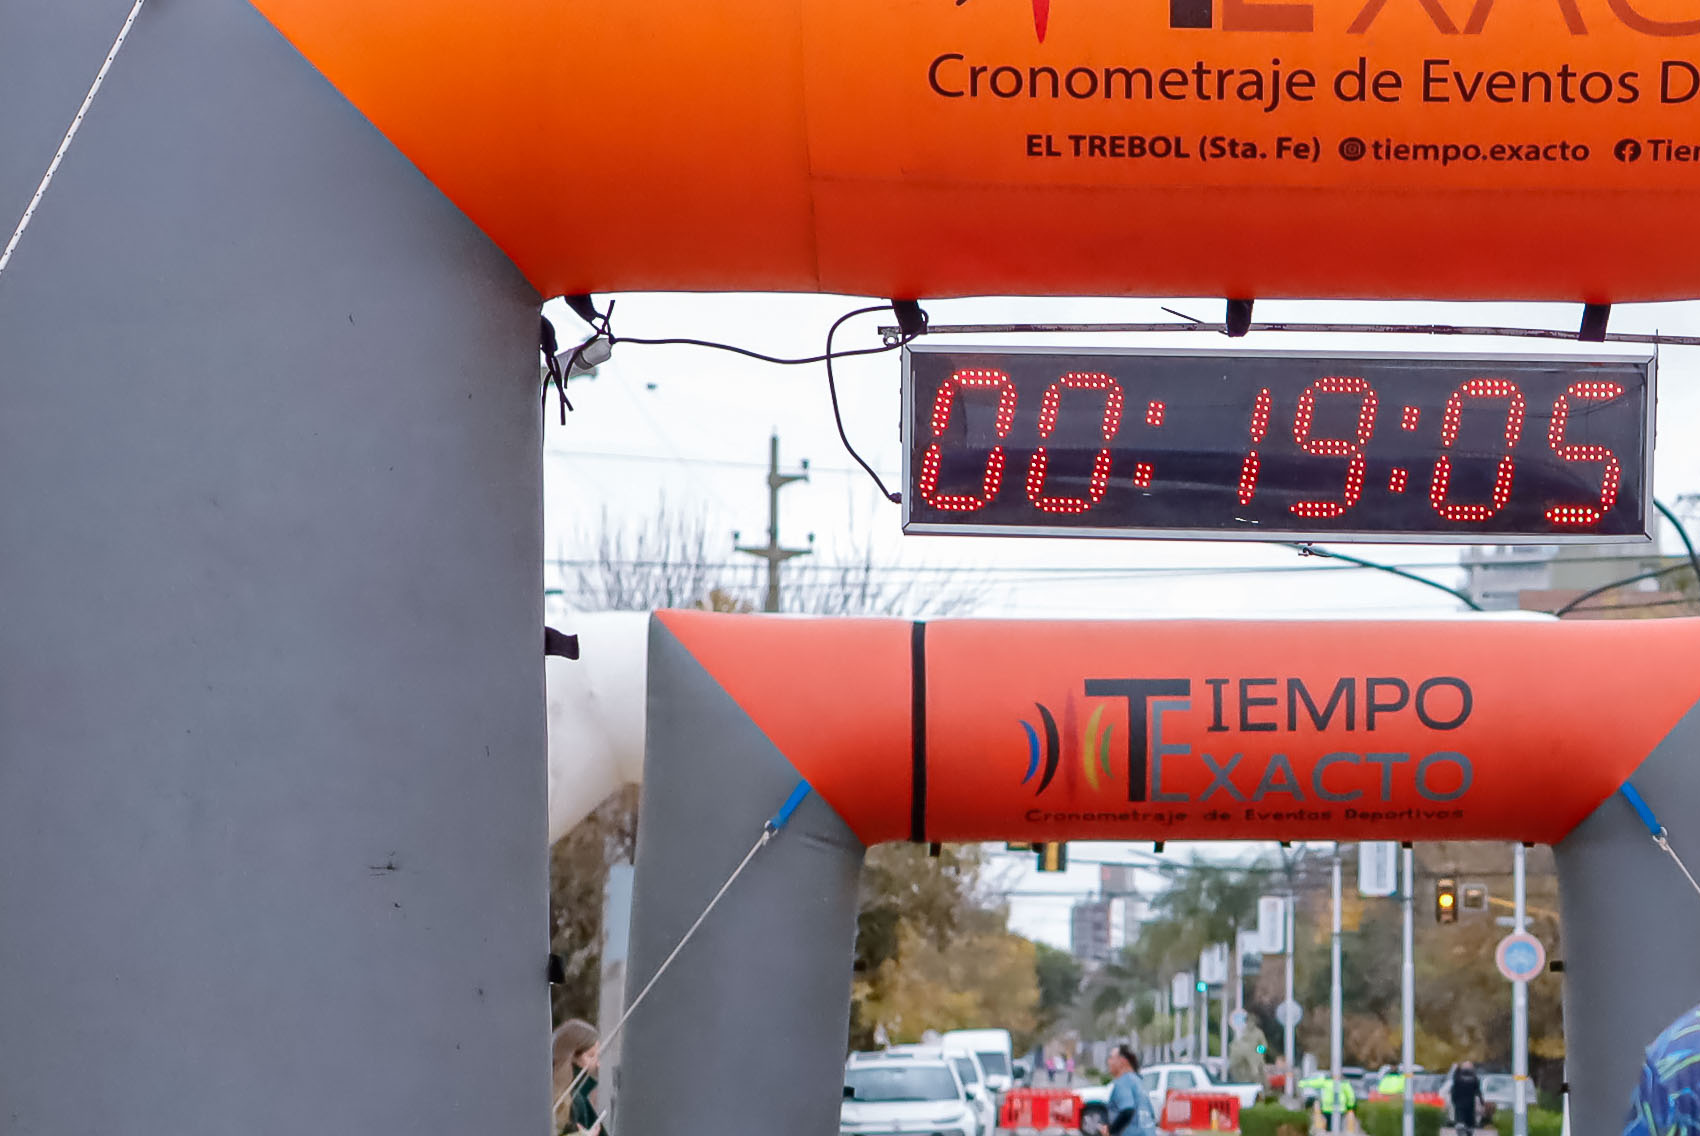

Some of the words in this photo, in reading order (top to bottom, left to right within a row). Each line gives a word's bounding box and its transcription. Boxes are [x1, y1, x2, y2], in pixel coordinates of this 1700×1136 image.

[928, 53, 1316, 112] Cronometraje
[1333, 57, 1402, 102] de
[1422, 59, 1640, 103] Eventos
[1026, 134, 1062, 157] EL
[1068, 134, 1190, 159] TREBOL
[1198, 136, 1267, 161] (Sta.
[1276, 136, 1321, 162] Fe)
[1372, 138, 1590, 165] tiempo.exacto
[919, 369, 1624, 524] 00:19:05
[1084, 677, 1474, 801] TIEMPO
[1150, 700, 1474, 801] EXACTO
[1024, 808, 1188, 826] Cronometraje
[1203, 808, 1231, 821] de
[1244, 808, 1332, 821] Eventos
[1344, 808, 1464, 823] Deportivos
